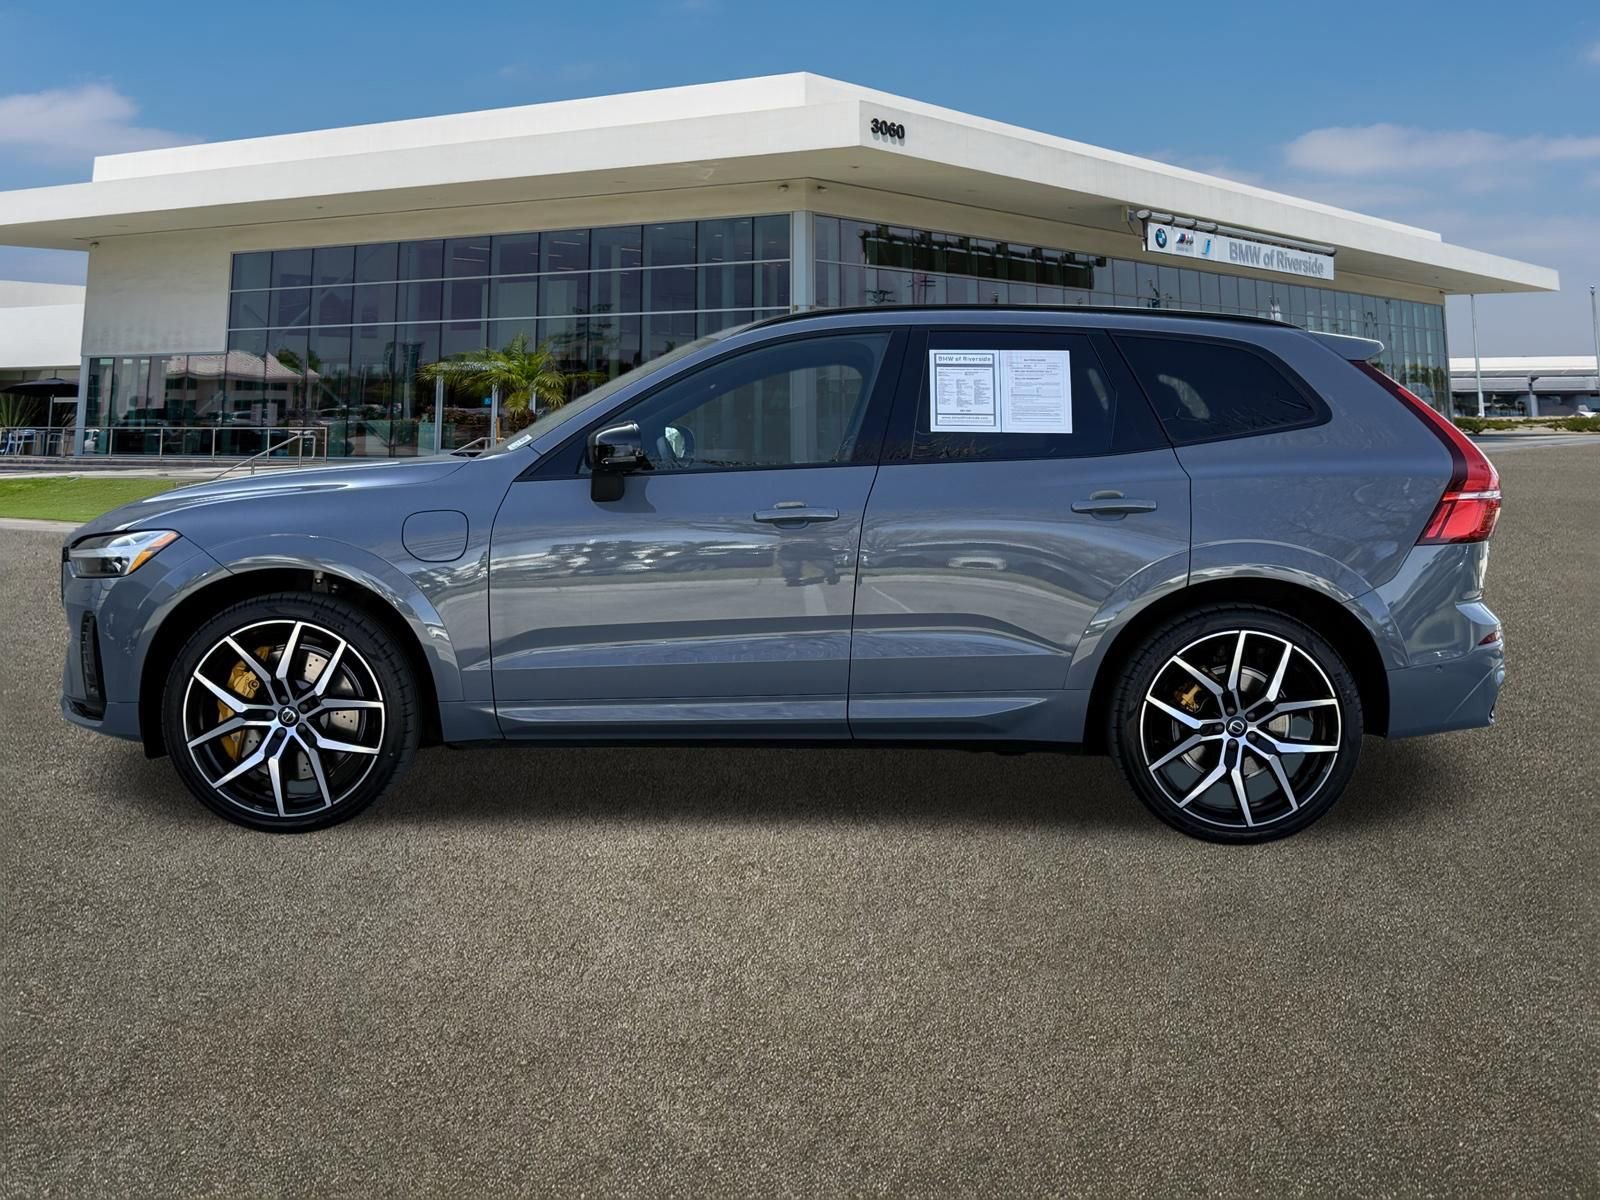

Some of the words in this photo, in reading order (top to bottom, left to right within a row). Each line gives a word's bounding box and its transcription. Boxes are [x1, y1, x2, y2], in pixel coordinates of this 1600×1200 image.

[871, 118, 905, 139] 3060
[1229, 241, 1260, 265] BMW
[1263, 249, 1274, 267] of
[1276, 250, 1324, 275] Riverside
